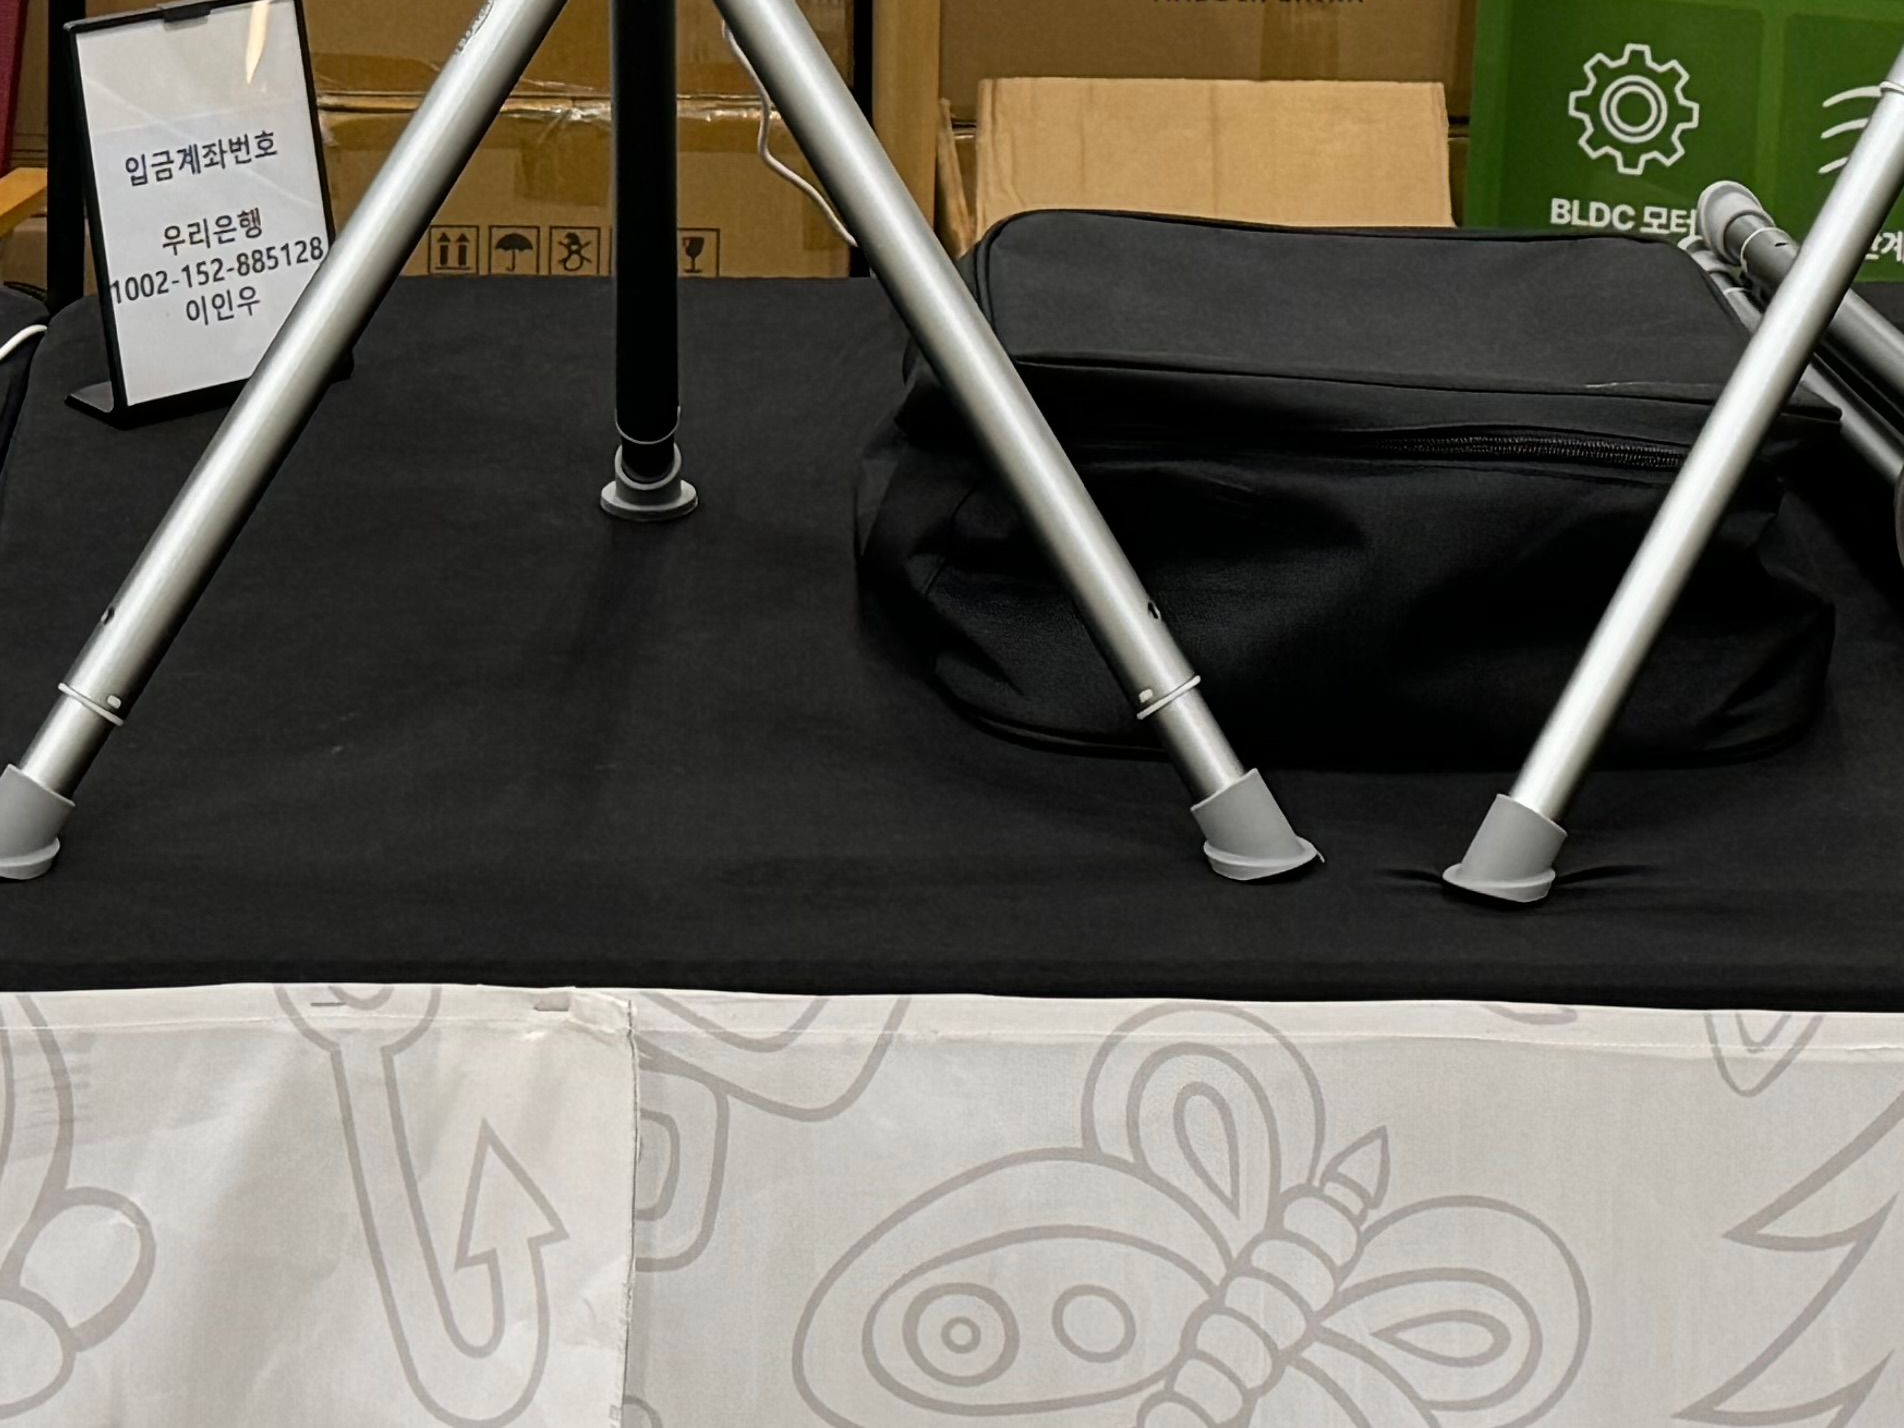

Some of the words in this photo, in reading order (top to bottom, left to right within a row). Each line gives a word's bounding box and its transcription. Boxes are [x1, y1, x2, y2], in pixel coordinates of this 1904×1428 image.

[124, 129, 279, 187] 입금계좌번호
[162, 207, 263, 256] 우리은행
[1550, 197, 1635, 230] BLDC
[1639, 204, 1698, 235] 모터
[109, 236, 325, 304] 1002-152-885128
[185, 285, 261, 327] 이인우
